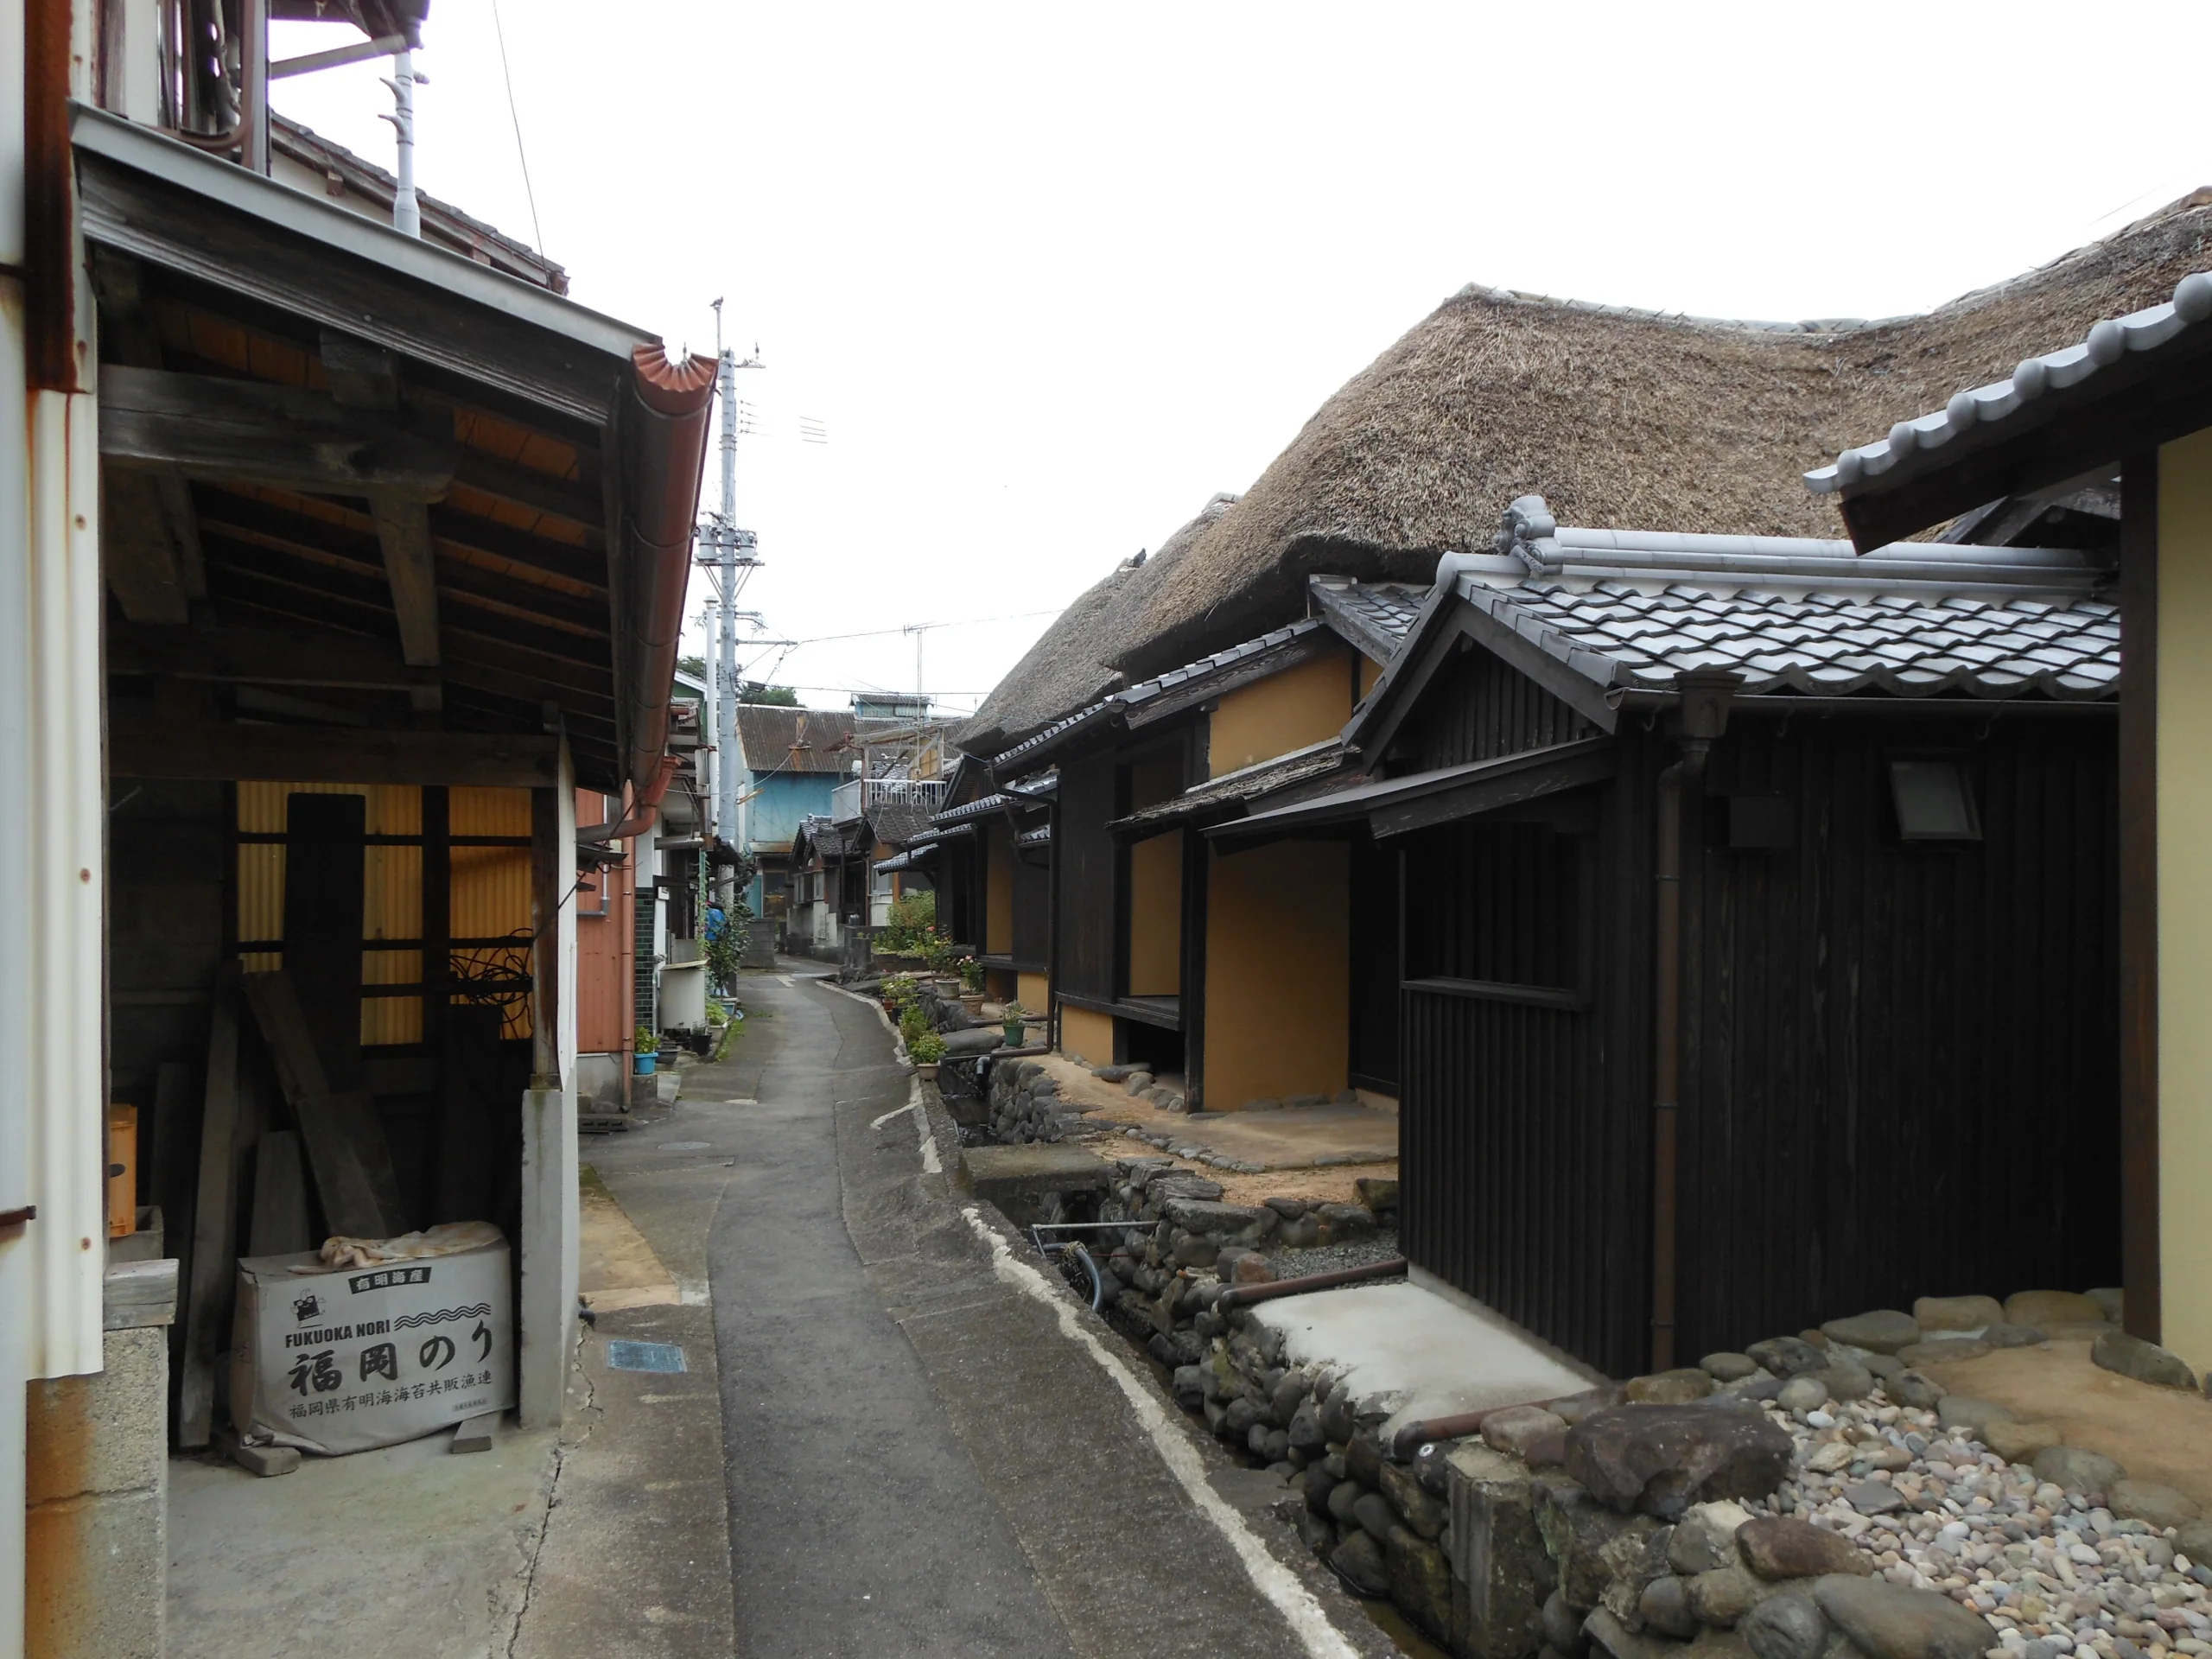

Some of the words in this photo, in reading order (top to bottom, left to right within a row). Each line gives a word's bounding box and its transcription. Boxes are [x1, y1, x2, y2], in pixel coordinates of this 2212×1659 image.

[355, 1268, 424, 1291] 有明海産
[285, 1325, 353, 1348] FUKUOKA
[356, 1319, 391, 1338] NORI
[288, 1319, 493, 1396] 福岡のり
[289, 1370, 493, 1419] 福岡県有明海海苔共販漁連
